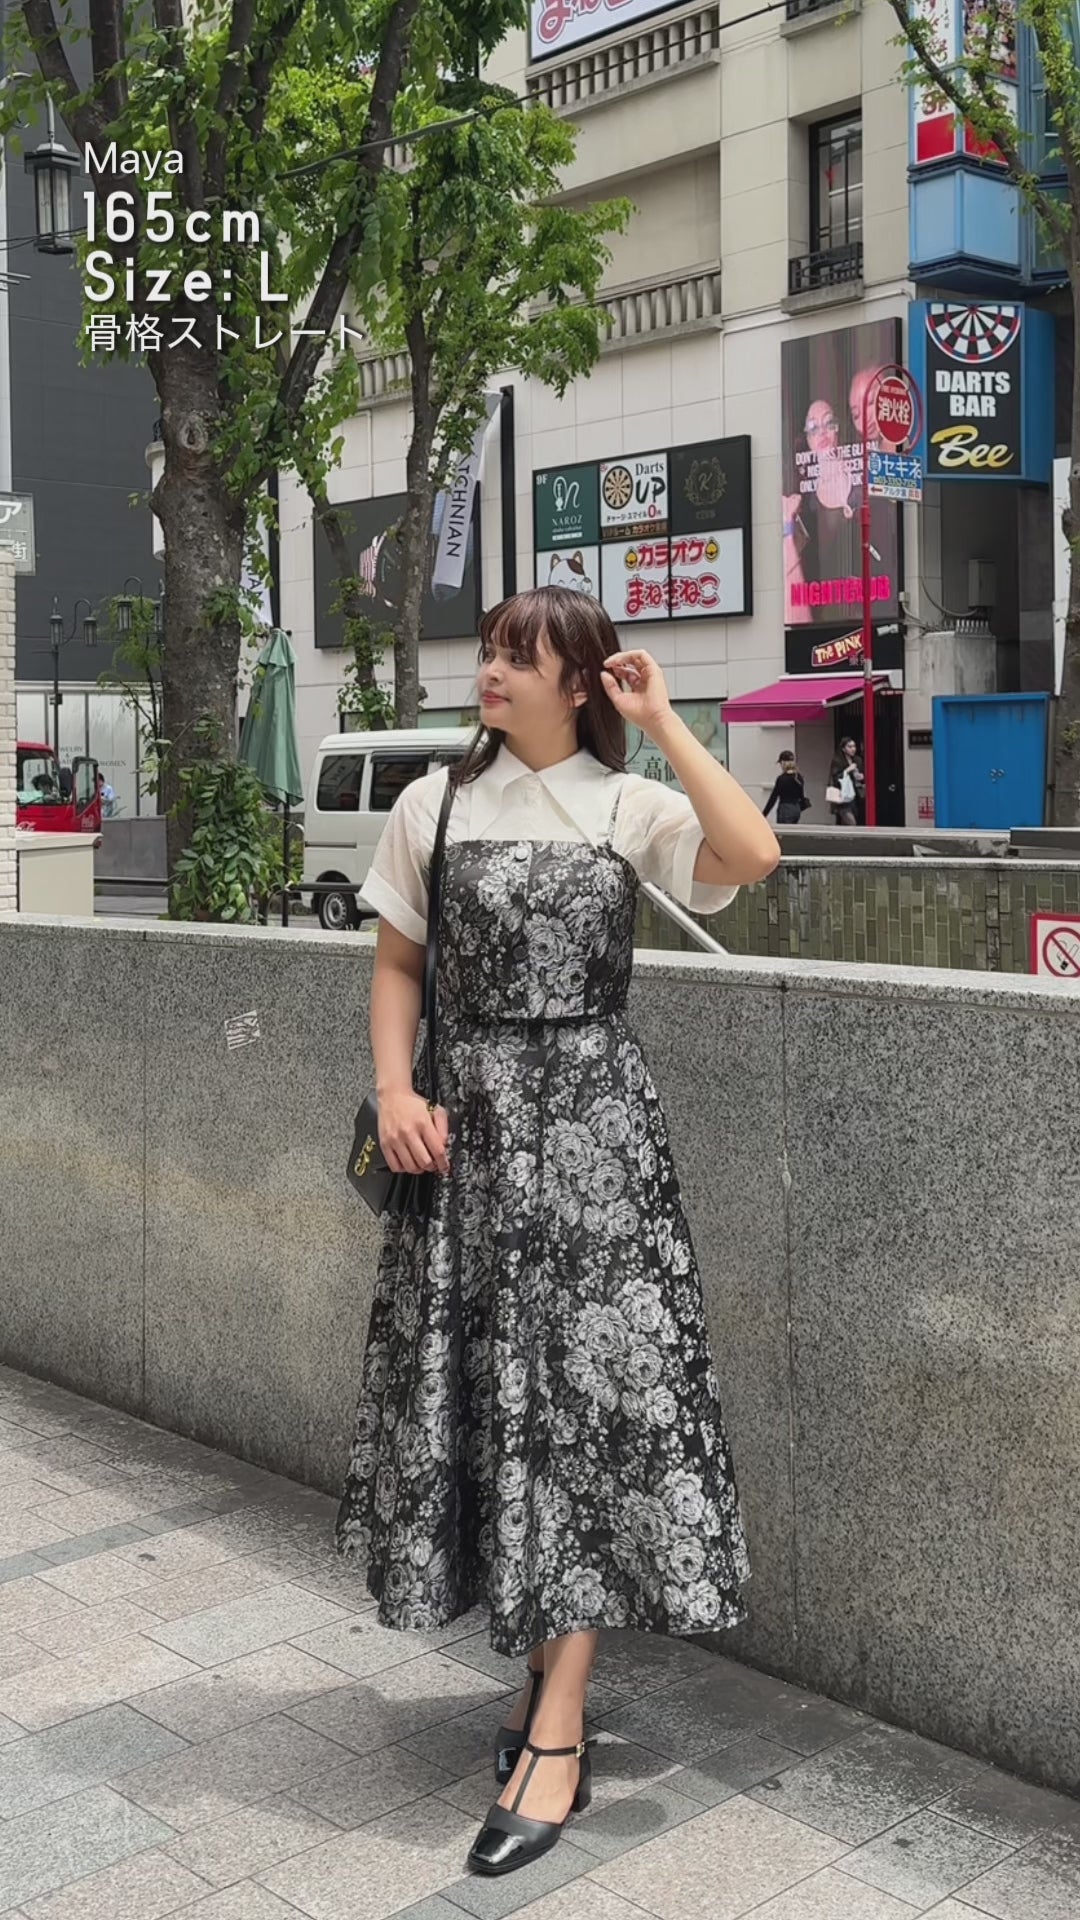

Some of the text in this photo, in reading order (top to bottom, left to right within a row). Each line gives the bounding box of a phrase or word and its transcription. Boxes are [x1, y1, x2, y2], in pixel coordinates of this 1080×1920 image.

[935, 370, 1011, 394] DARTS
[878, 396, 911, 426] 消火栓
[949, 394, 996, 417] BAR
[930, 424, 1015, 468] Bee
[635, 461, 665, 476] Darts
[635, 476, 667, 504] UP
[552, 514, 583, 526] NAROZ
[637, 538, 706, 569] カラオケ
[625, 574, 720, 617] まねきねこ
